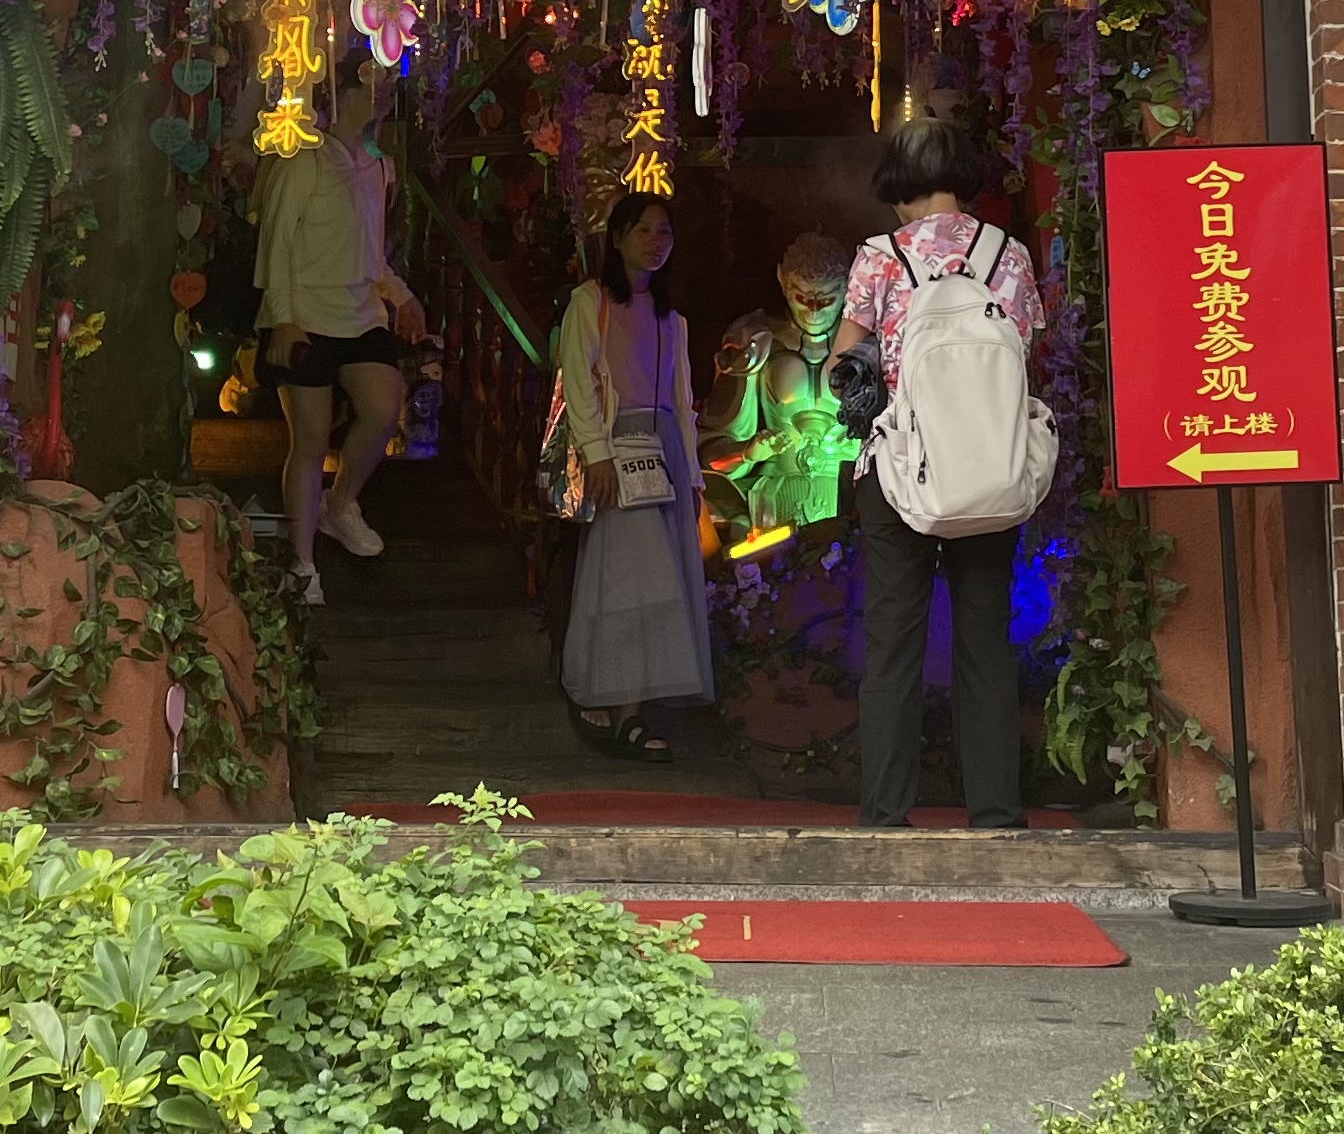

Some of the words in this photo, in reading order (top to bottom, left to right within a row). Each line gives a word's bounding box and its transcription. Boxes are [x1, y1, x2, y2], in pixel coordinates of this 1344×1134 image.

[1186, 160, 1257, 403] 今日免费参观
